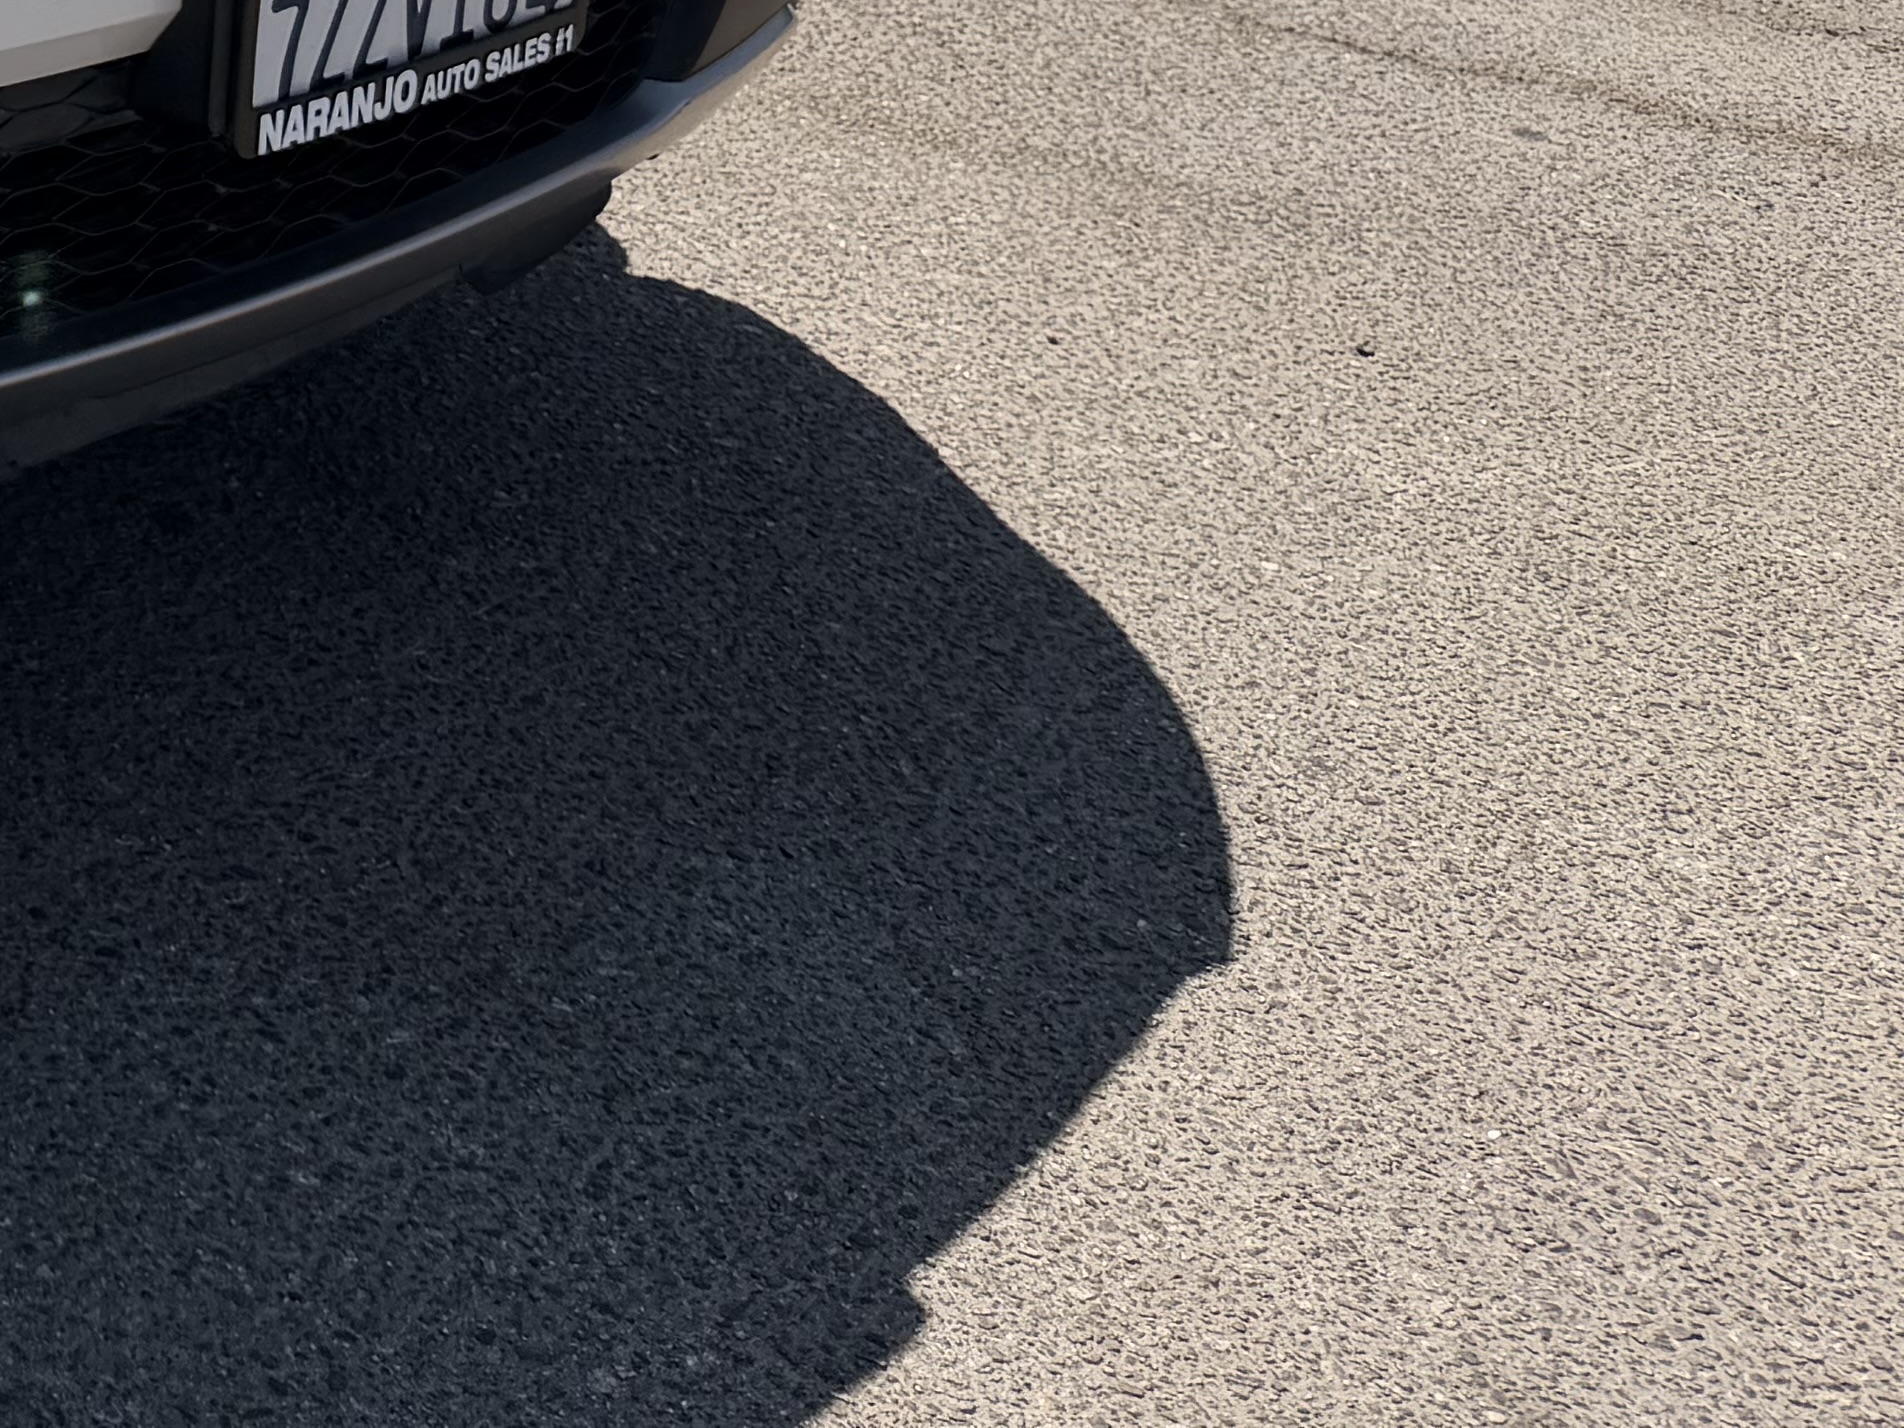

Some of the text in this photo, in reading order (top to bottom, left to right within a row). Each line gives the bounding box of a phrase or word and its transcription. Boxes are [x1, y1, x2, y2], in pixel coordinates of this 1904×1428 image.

[257, 69, 418, 157] NARANJO
[421, 58, 480, 107] AUTO
[484, 31, 551, 83] SALES
